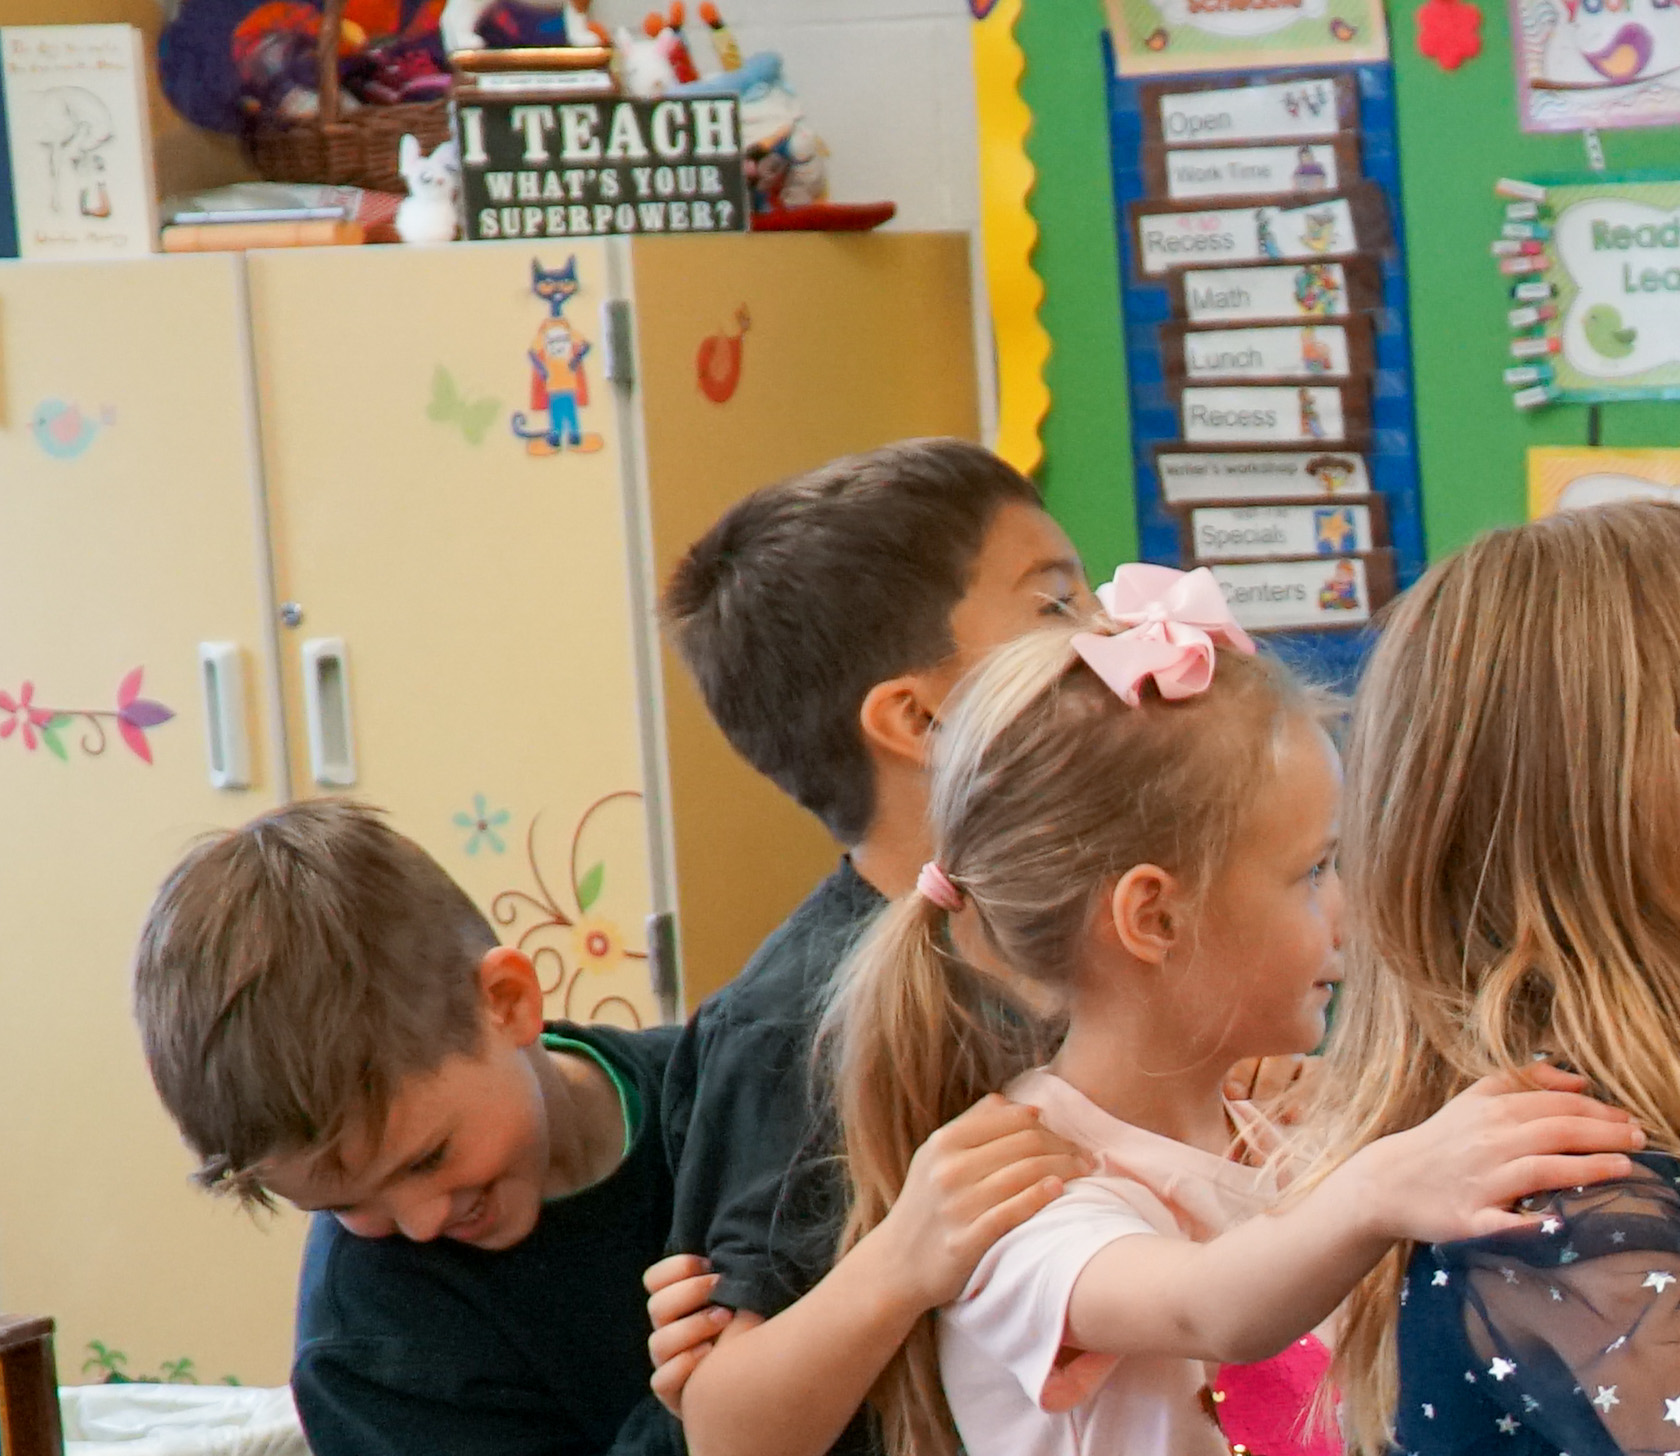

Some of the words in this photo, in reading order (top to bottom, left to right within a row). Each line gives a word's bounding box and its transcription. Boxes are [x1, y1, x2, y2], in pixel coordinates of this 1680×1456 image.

[460, 106, 489, 164] I
[510, 99, 739, 163] TEACH
[1167, 110, 1232, 136] Open
[484, 167, 621, 201] WHAT'S
[631, 164, 724, 198] YOUR
[479, 199, 736, 238] SUPERPOWER?
[1147, 230, 1236, 252] Recess
[1192, 286, 1250, 310] Math
[1191, 346, 1264, 371] Lunch
[1190, 403, 1278, 428] Recess
[1200, 523, 1287, 548] Specials
[1219, 581, 1307, 603] Centers
